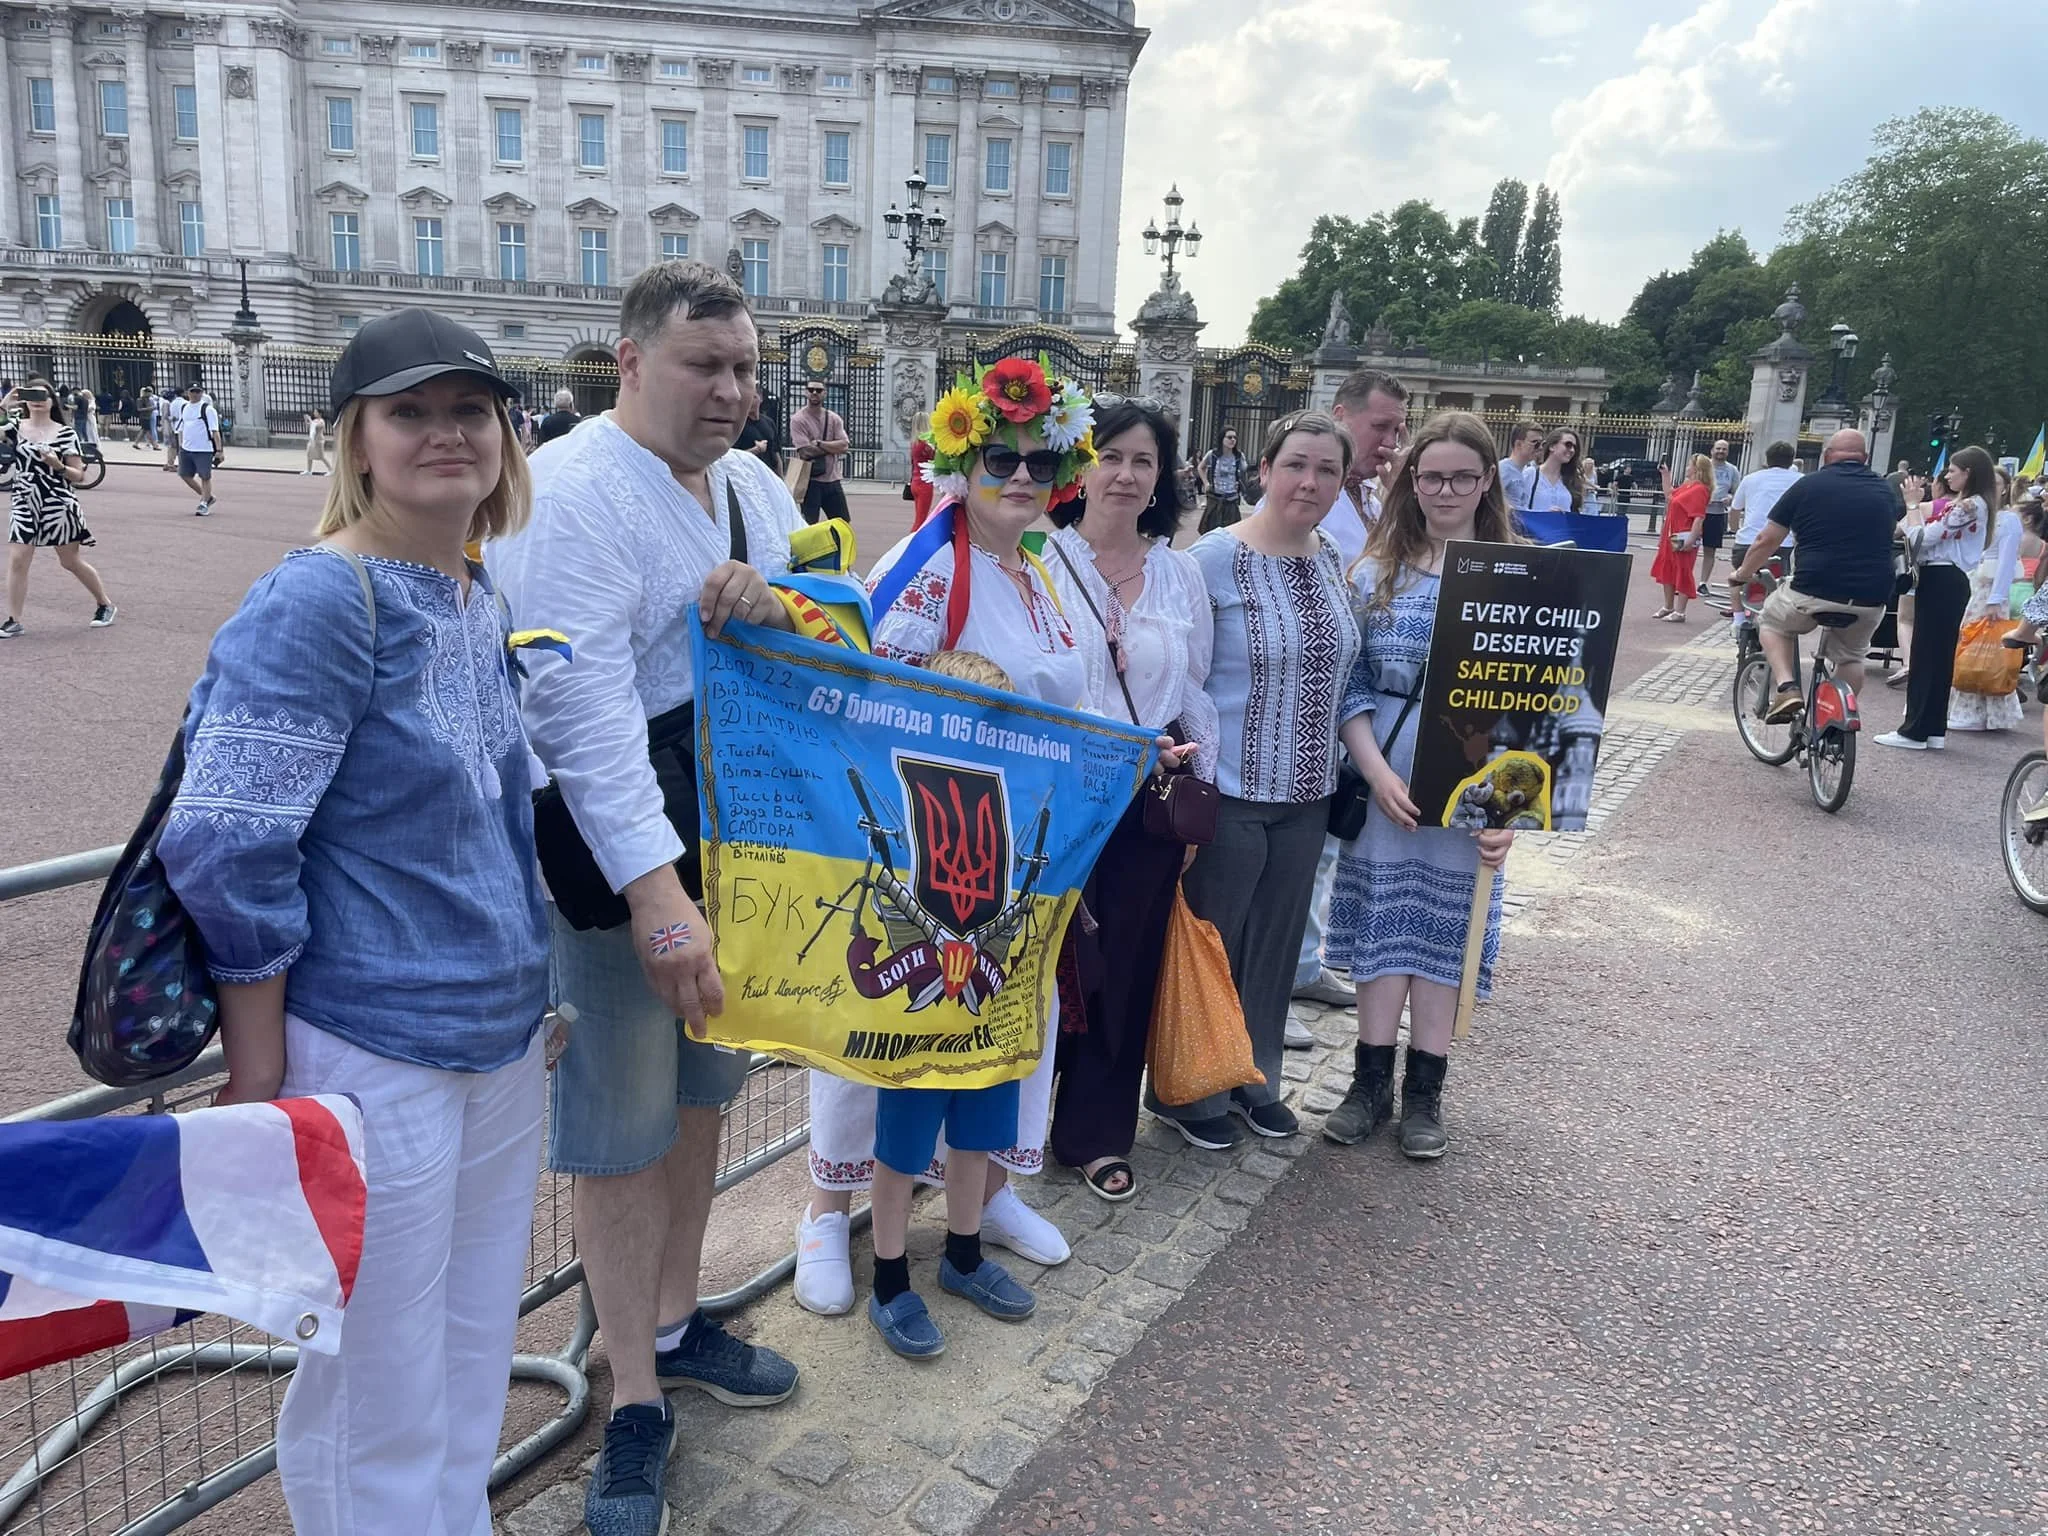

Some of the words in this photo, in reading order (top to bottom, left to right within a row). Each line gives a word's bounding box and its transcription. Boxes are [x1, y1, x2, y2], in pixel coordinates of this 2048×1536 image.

[1461, 602, 1531, 624] EVERY
[1535, 607, 1600, 629] CHILD
[1473, 632, 1580, 656] DESERVES
[1458, 660, 1536, 683] SAFETY
[1540, 666, 1585, 685] AND
[1449, 689, 1579, 713] CHILDHOOD
[808, 686, 842, 715] 63
[844, 693, 933, 736] бригада
[941, 712, 972, 742] 105
[976, 721, 1071, 763] батальйон
[732, 877, 804, 930] БУК
[877, 948, 926, 991] БОГИ
